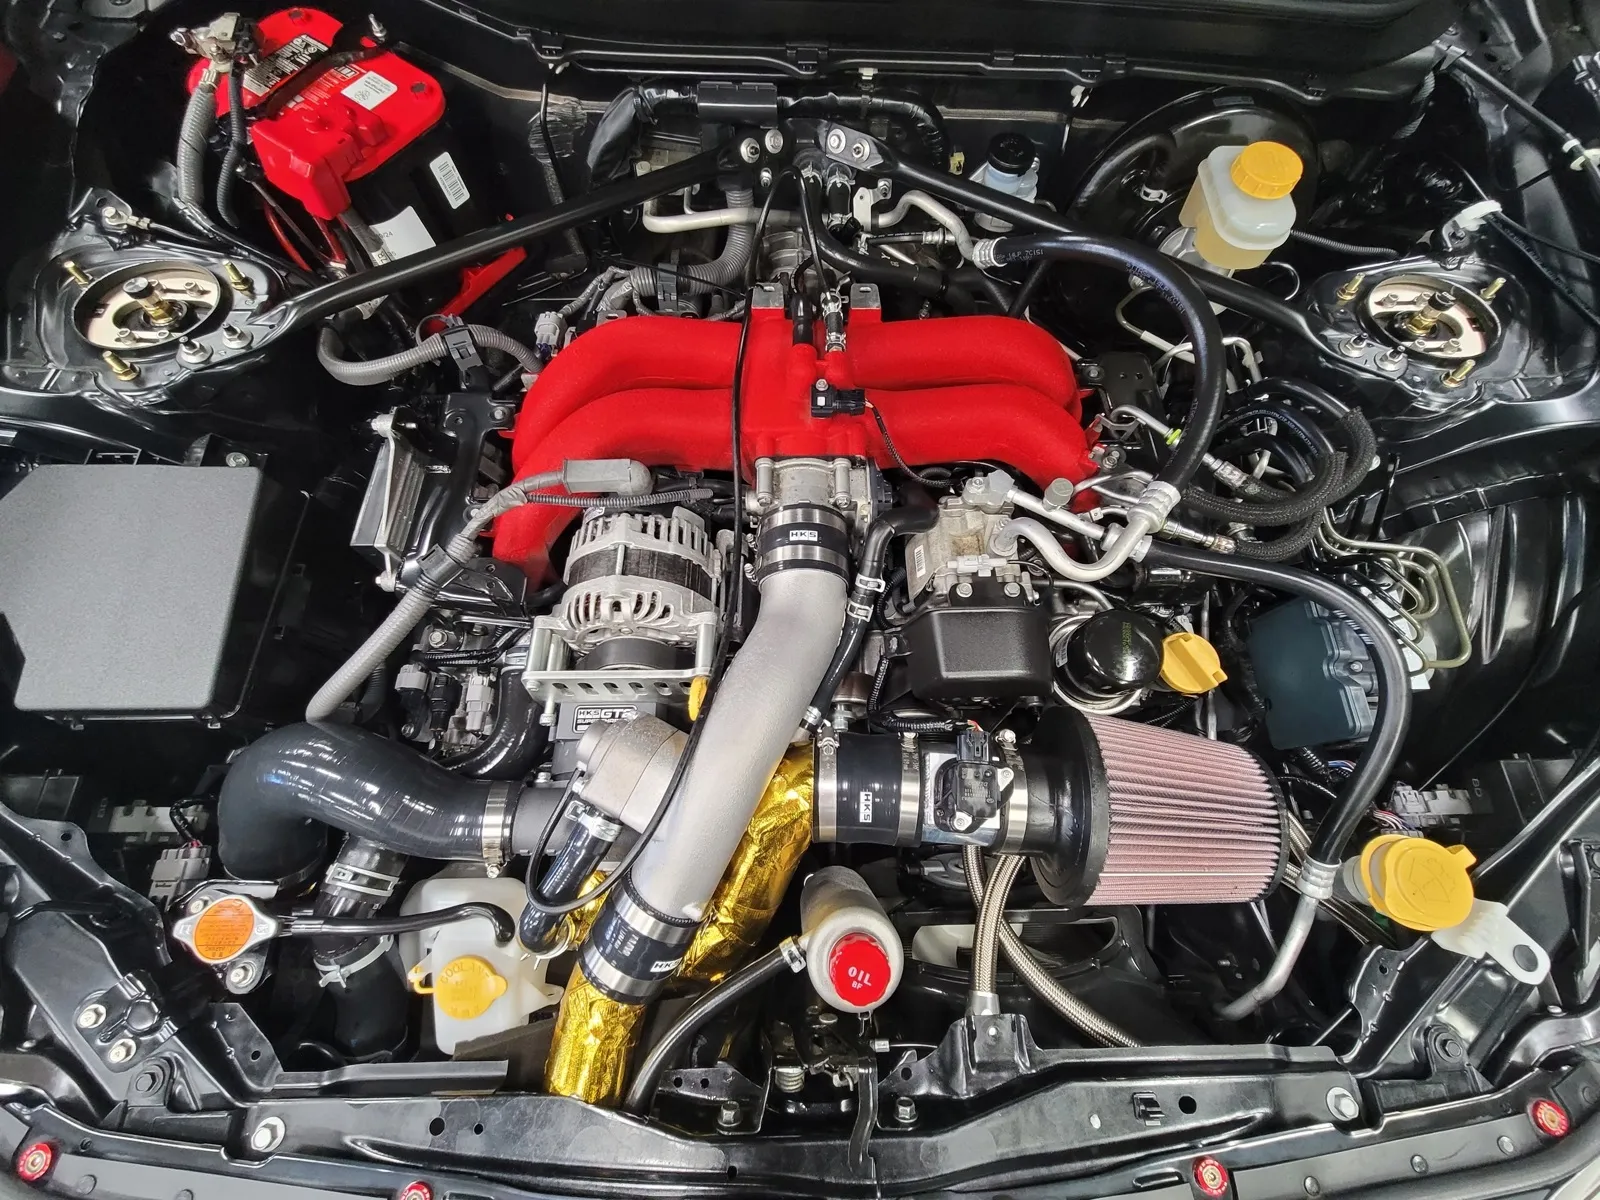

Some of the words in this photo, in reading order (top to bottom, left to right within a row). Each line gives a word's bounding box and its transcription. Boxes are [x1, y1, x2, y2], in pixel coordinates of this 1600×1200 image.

[790, 531, 817, 540] HKS
[578, 709, 600, 717] HKS
[861, 793, 872, 822] HKS
[653, 960, 681, 970] HKS
[847, 966, 872, 986] OIL
